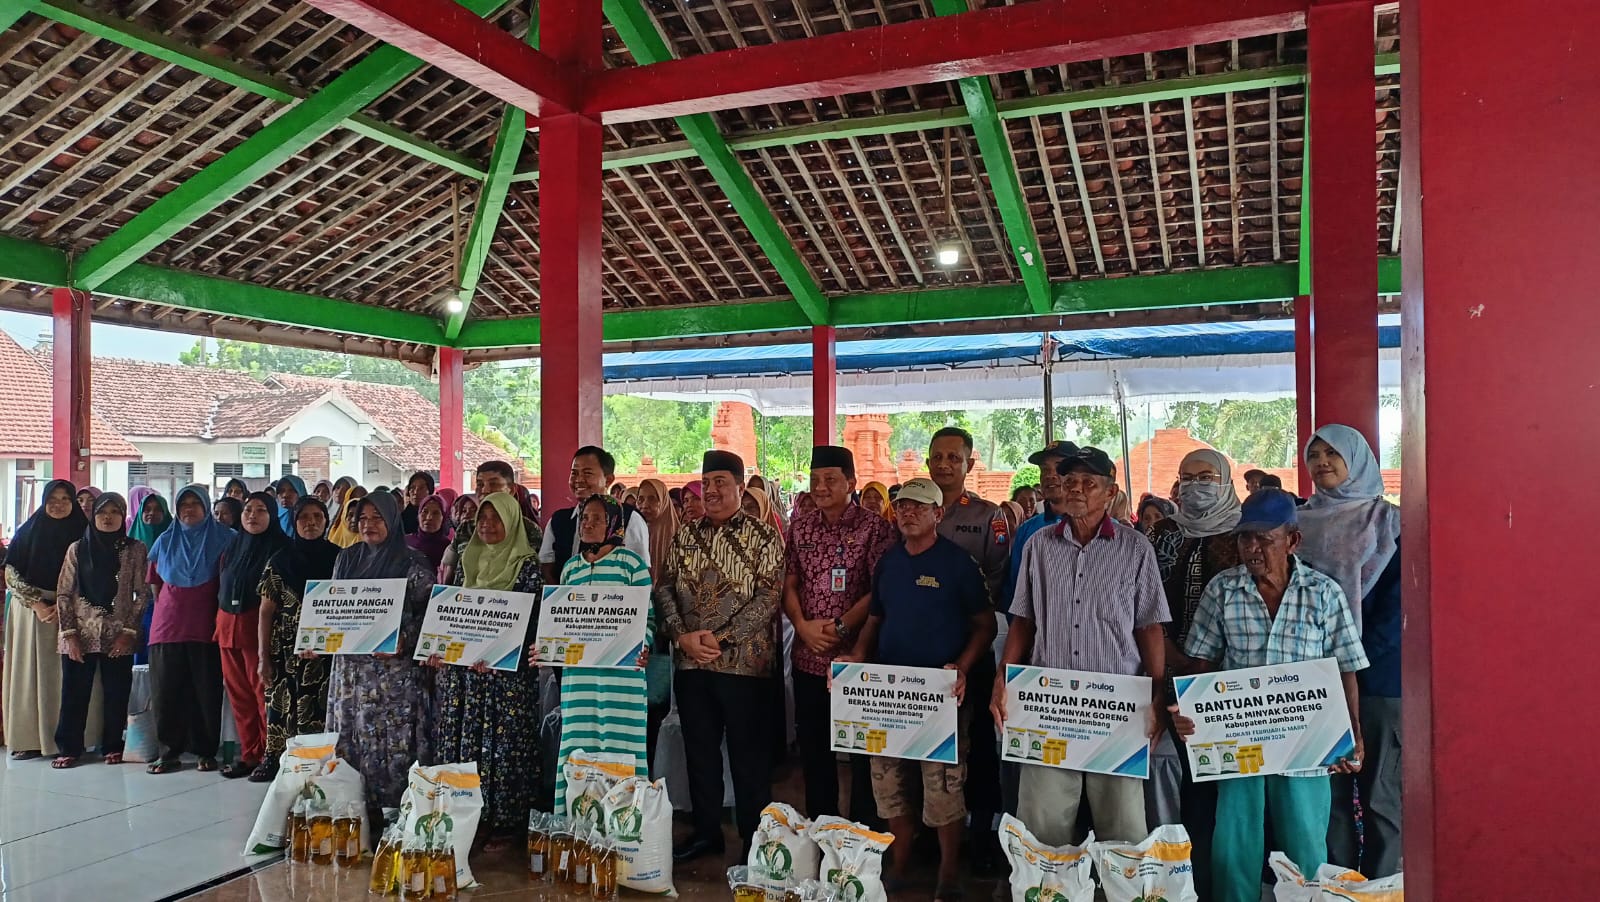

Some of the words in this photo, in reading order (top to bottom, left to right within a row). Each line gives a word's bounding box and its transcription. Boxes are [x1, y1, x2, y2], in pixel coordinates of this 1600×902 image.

[956, 525, 981, 533] POLRI
[312, 599, 355, 607] BANTUAN
[356, 598, 394, 606] PANGAN
[437, 605, 480, 616] BANTUAN
[482, 610, 520, 620] PANGAN
[551, 606, 595, 615] BANTUAN
[598, 607, 637, 616] PANGAN
[906, 676, 925, 685] bulog
[1274, 674, 1299, 683] bulog
[1091, 682, 1114, 692] bulog
[843, 687, 895, 699] BANTUAN
[897, 691, 944, 703] PANGAN
[1194, 696, 1264, 714] BANTUAN
[1266, 688, 1328, 705] PANGAN
[879, 701, 906, 709] MINYAK
[907, 704, 938, 712] GORENG
[1018, 691, 1078, 706] BANTUAN
[1081, 698, 1136, 713] PANGAN
[1024, 704, 1049, 714] BERAS
[1059, 708, 1090, 718] MINYAK
[1093, 712, 1129, 722] GORENG
[1204, 713, 1234, 724] BERAS
[1236, 712, 1242, 720] &
[1244, 708, 1280, 719] MINYAK
[1282, 703, 1323, 714] GORENG
[1040, 714, 1077, 724] Kabupaten
[1079, 718, 1110, 728] Jombang
[1225, 719, 1268, 730] Kabupaten
[1269, 714, 1305, 725] Jombang
[766, 892, 773, 900] 10
